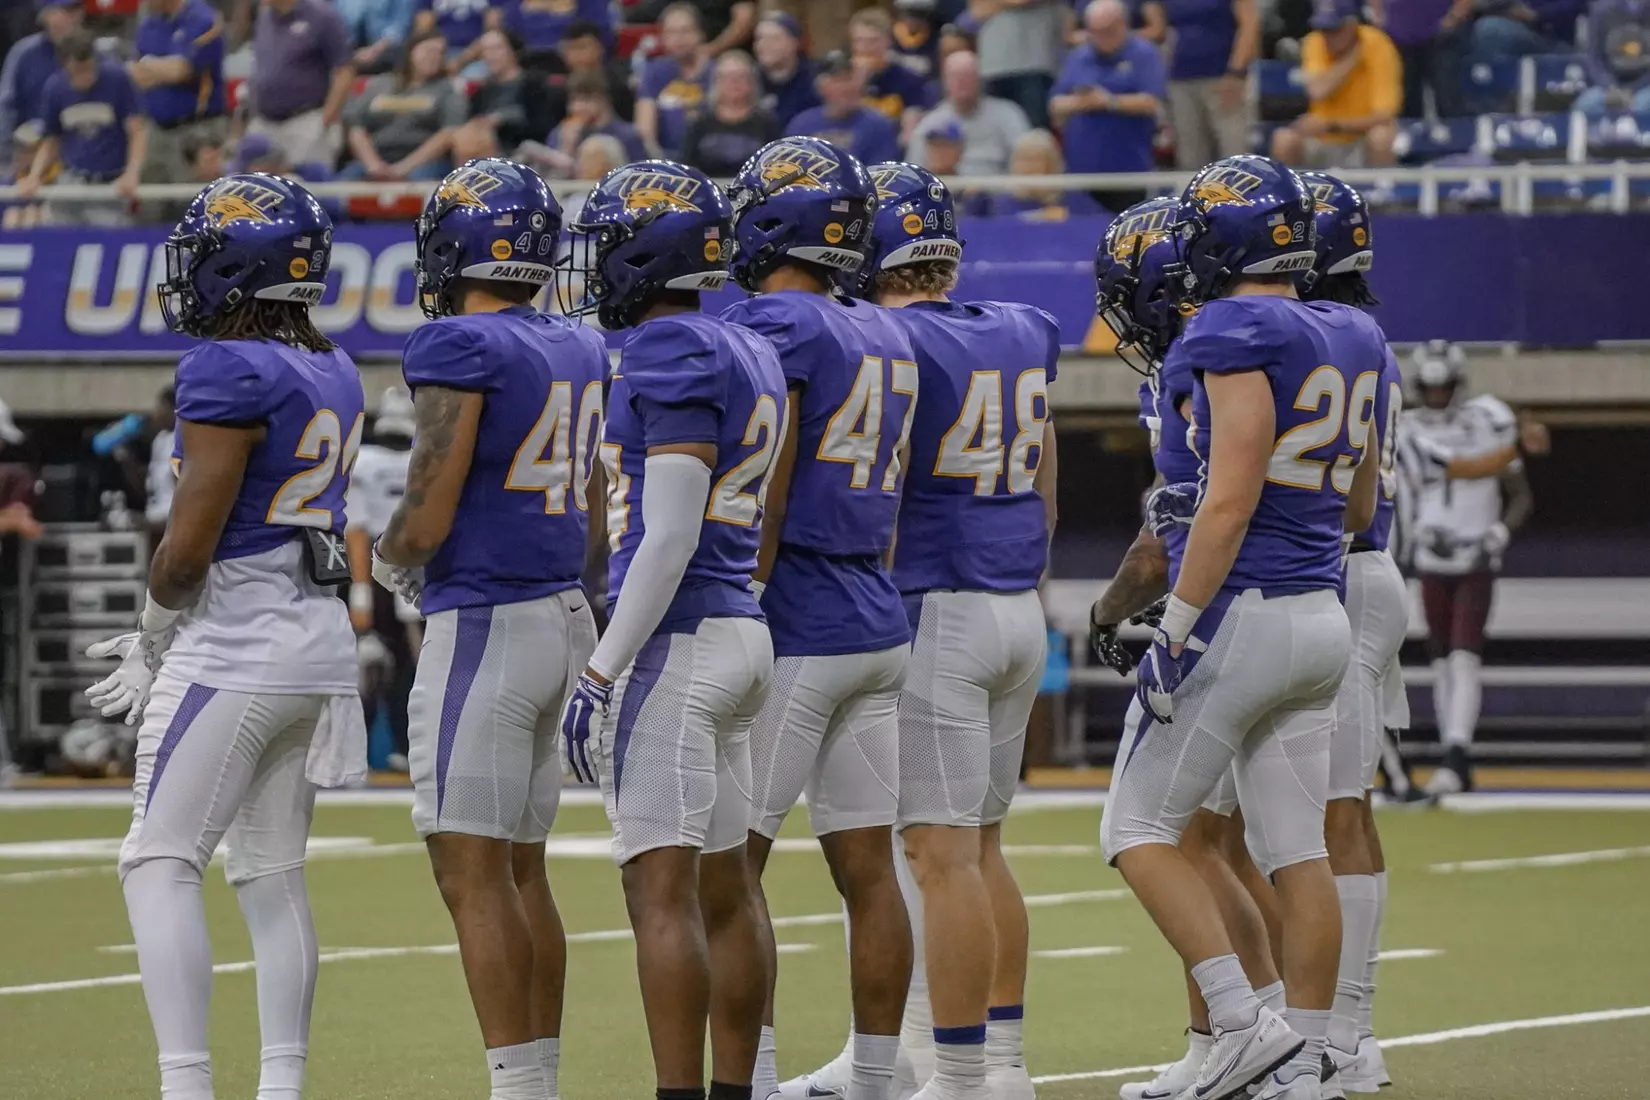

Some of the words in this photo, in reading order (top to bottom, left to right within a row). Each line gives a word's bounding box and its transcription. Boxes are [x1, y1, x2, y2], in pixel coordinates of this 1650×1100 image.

[514, 231, 551, 256] 40
[618, 171, 702, 201] UNI
[923, 208, 954, 231] 48
[504, 380, 605, 515] 40
[706, 393, 789, 527] 2
[816, 354, 918, 492] 47
[932, 367, 1048, 497] 48
[1265, 364, 1379, 495] 29
